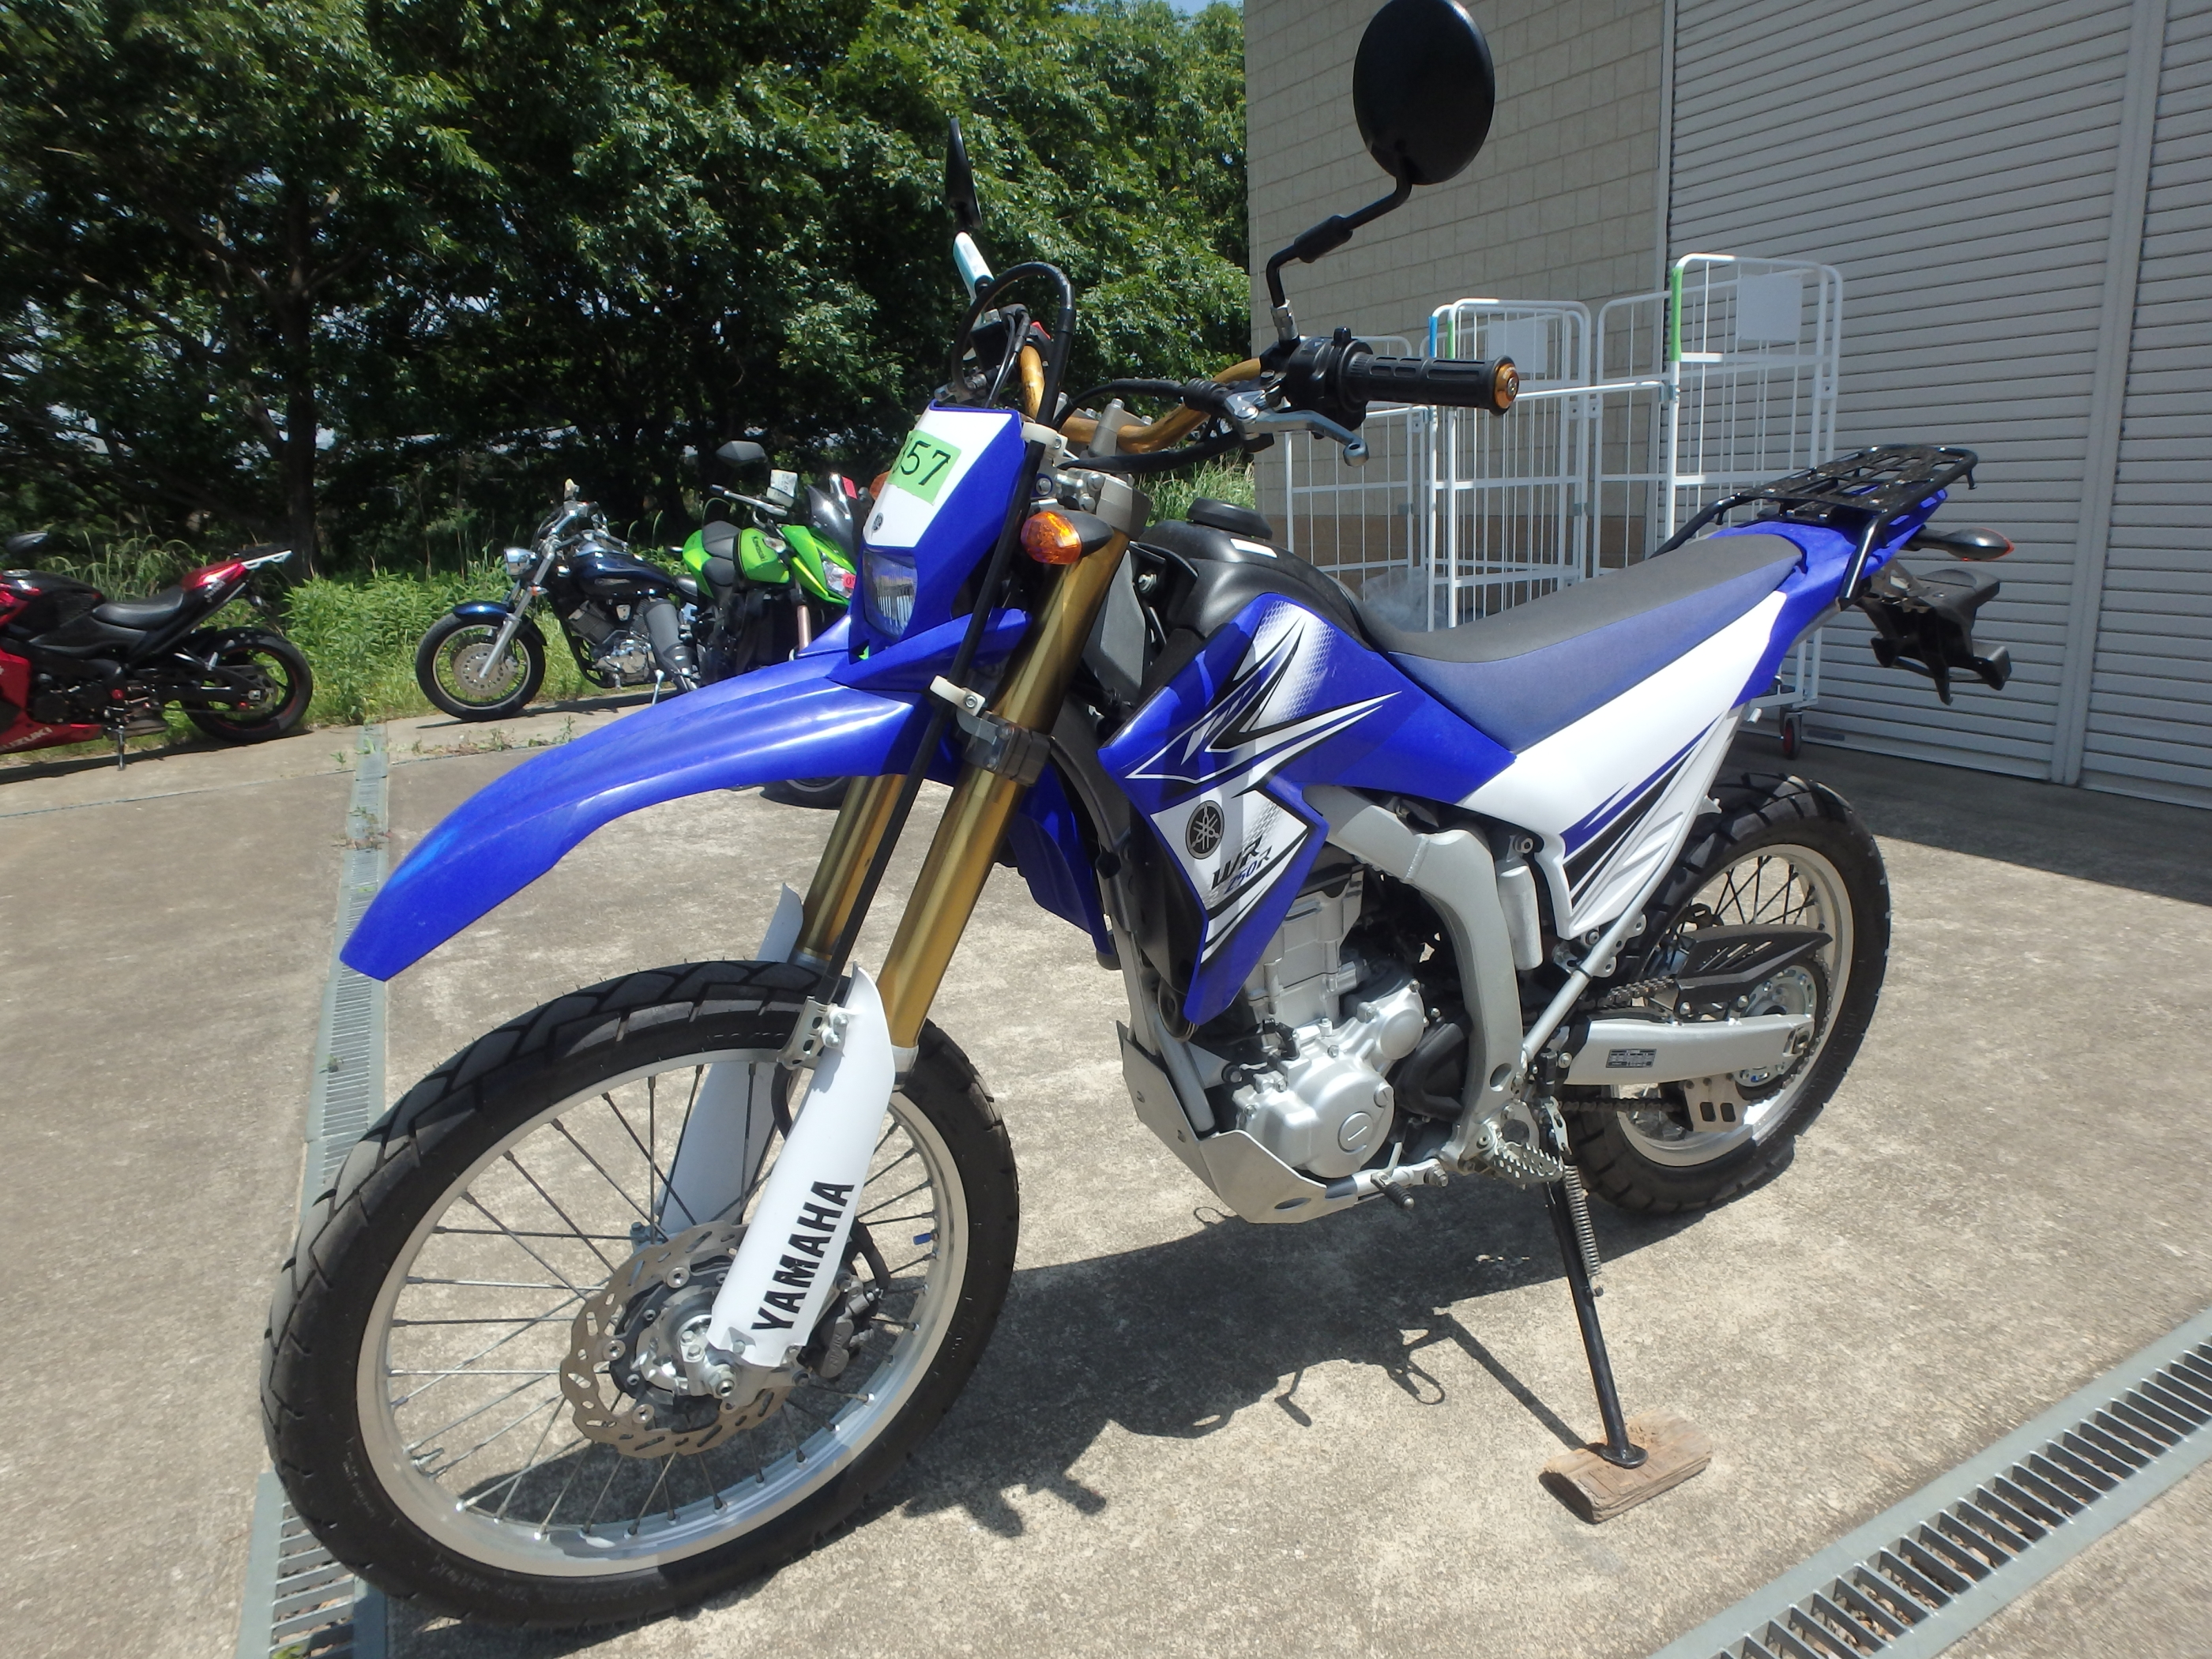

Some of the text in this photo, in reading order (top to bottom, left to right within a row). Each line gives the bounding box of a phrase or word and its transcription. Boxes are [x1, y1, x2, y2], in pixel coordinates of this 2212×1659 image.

[751, 536, 769, 562] Kawasaki
[0, 726, 53, 750] UZUKI
[1210, 834, 1263, 890] WR
[1224, 845, 1273, 895] 250R
[750, 1181, 855, 1330] YAMAHA
